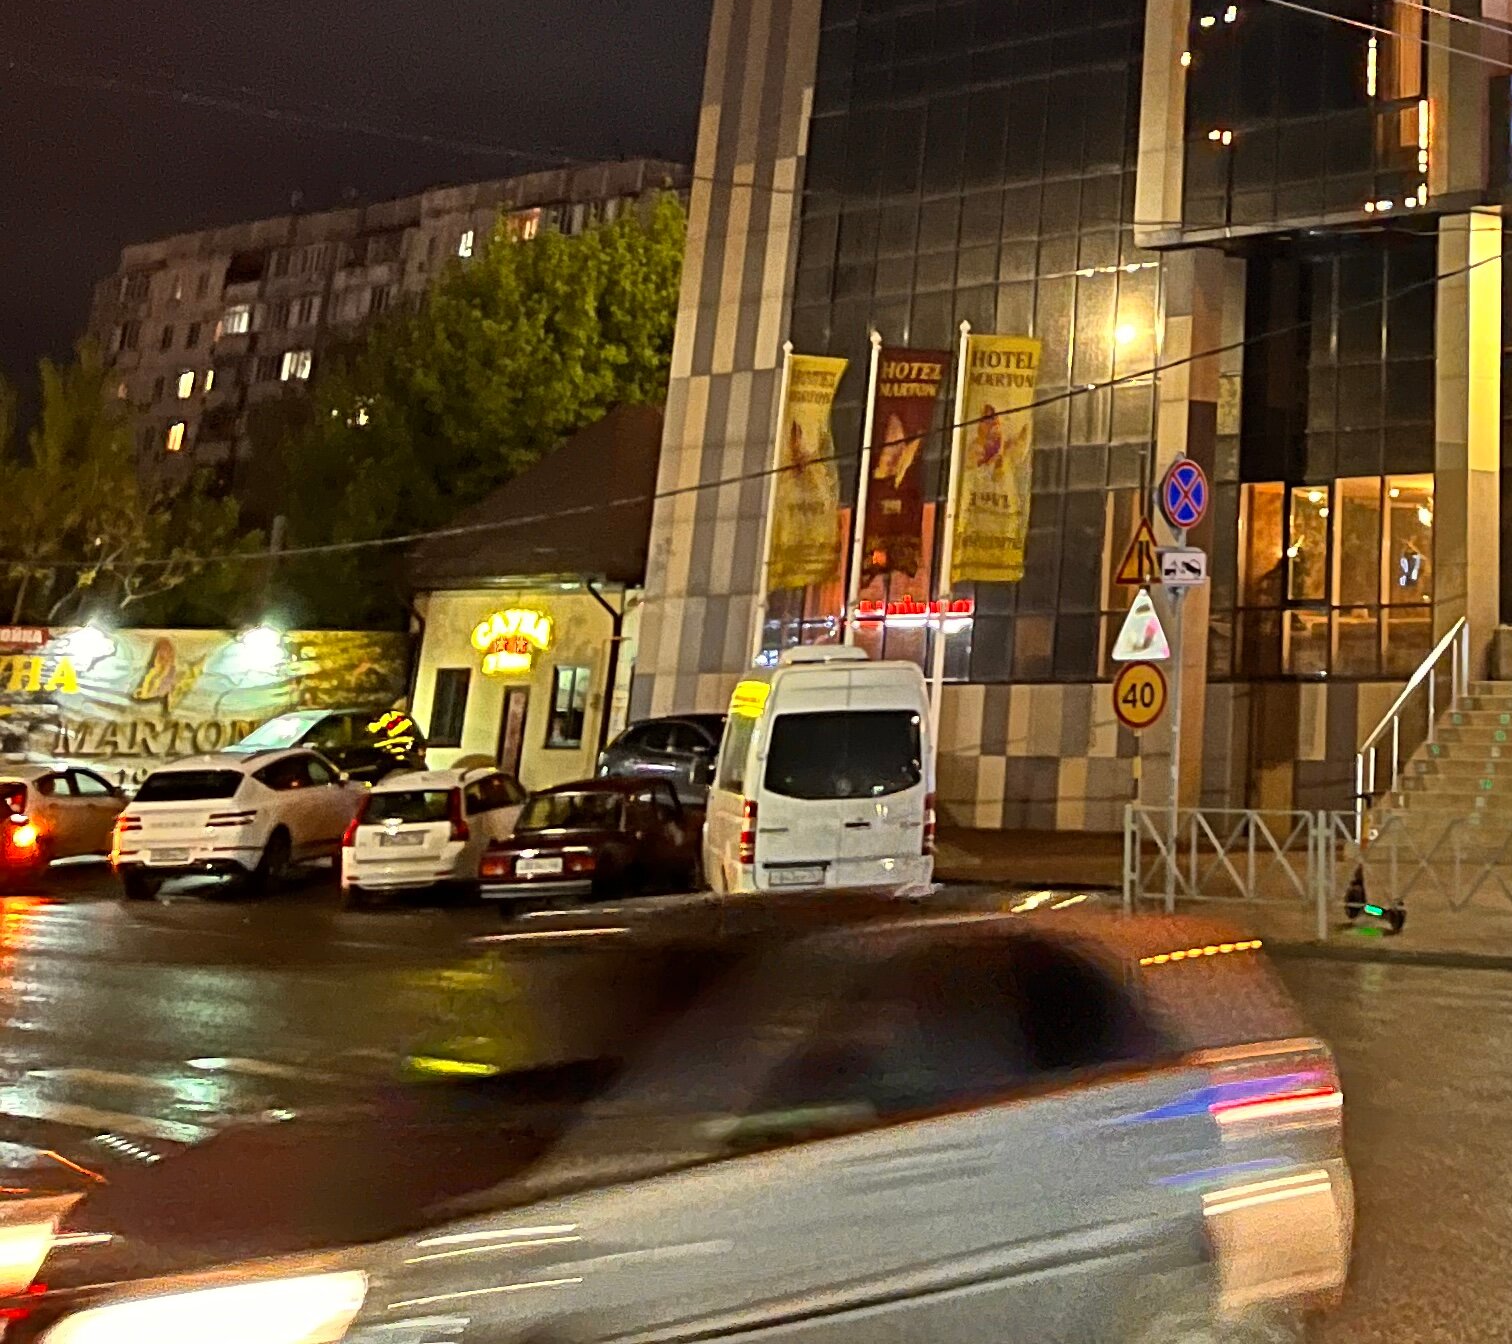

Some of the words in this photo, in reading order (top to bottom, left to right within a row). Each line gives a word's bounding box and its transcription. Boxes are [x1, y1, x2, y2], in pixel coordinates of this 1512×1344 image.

[973, 350, 1036, 369] HOTEL
[882, 363, 943, 380] HOTEL
[970, 372, 1034, 388] MARTON
[1122, 682, 1155, 708] 40
